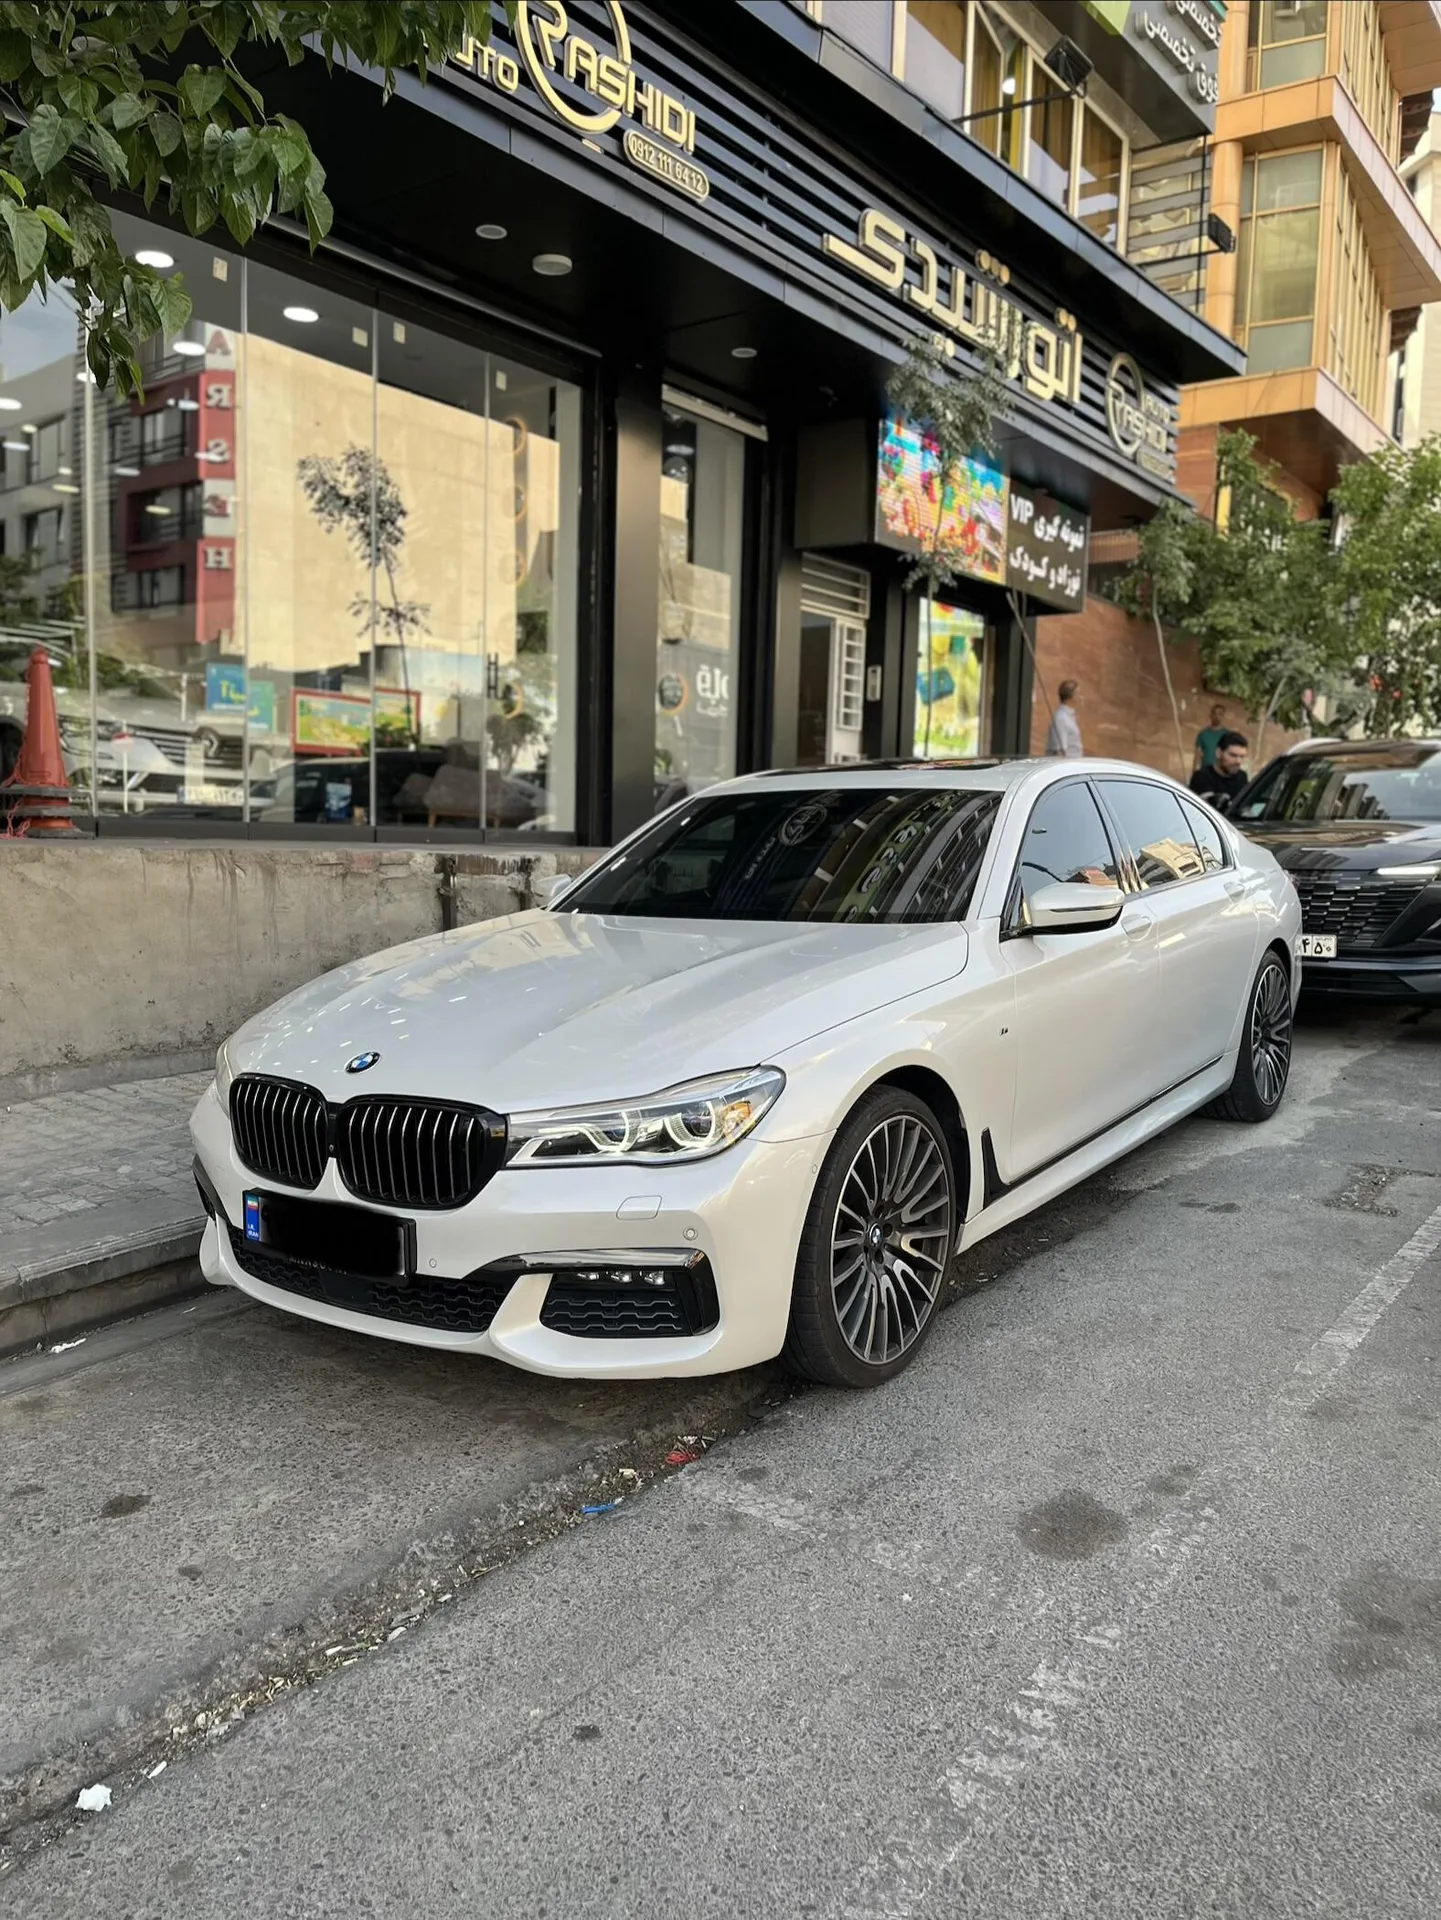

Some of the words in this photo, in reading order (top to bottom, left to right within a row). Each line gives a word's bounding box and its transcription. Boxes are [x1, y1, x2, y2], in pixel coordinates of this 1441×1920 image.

[1143, 9, 1196, 73] تخصصی
[527, 0, 697, 156] RASHIDI
[630, 136, 655, 165] 0912
[657, 151, 673, 175] 111
[1021, 307, 1084, 404] اتو
[1010, 493, 1034, 525] VIP
[1034, 515, 1062, 542] گیری
[1060, 519, 1084, 552] نمونه
[1048, 568, 1057, 589] و
[1056, 563, 1082, 598] نوزاد
